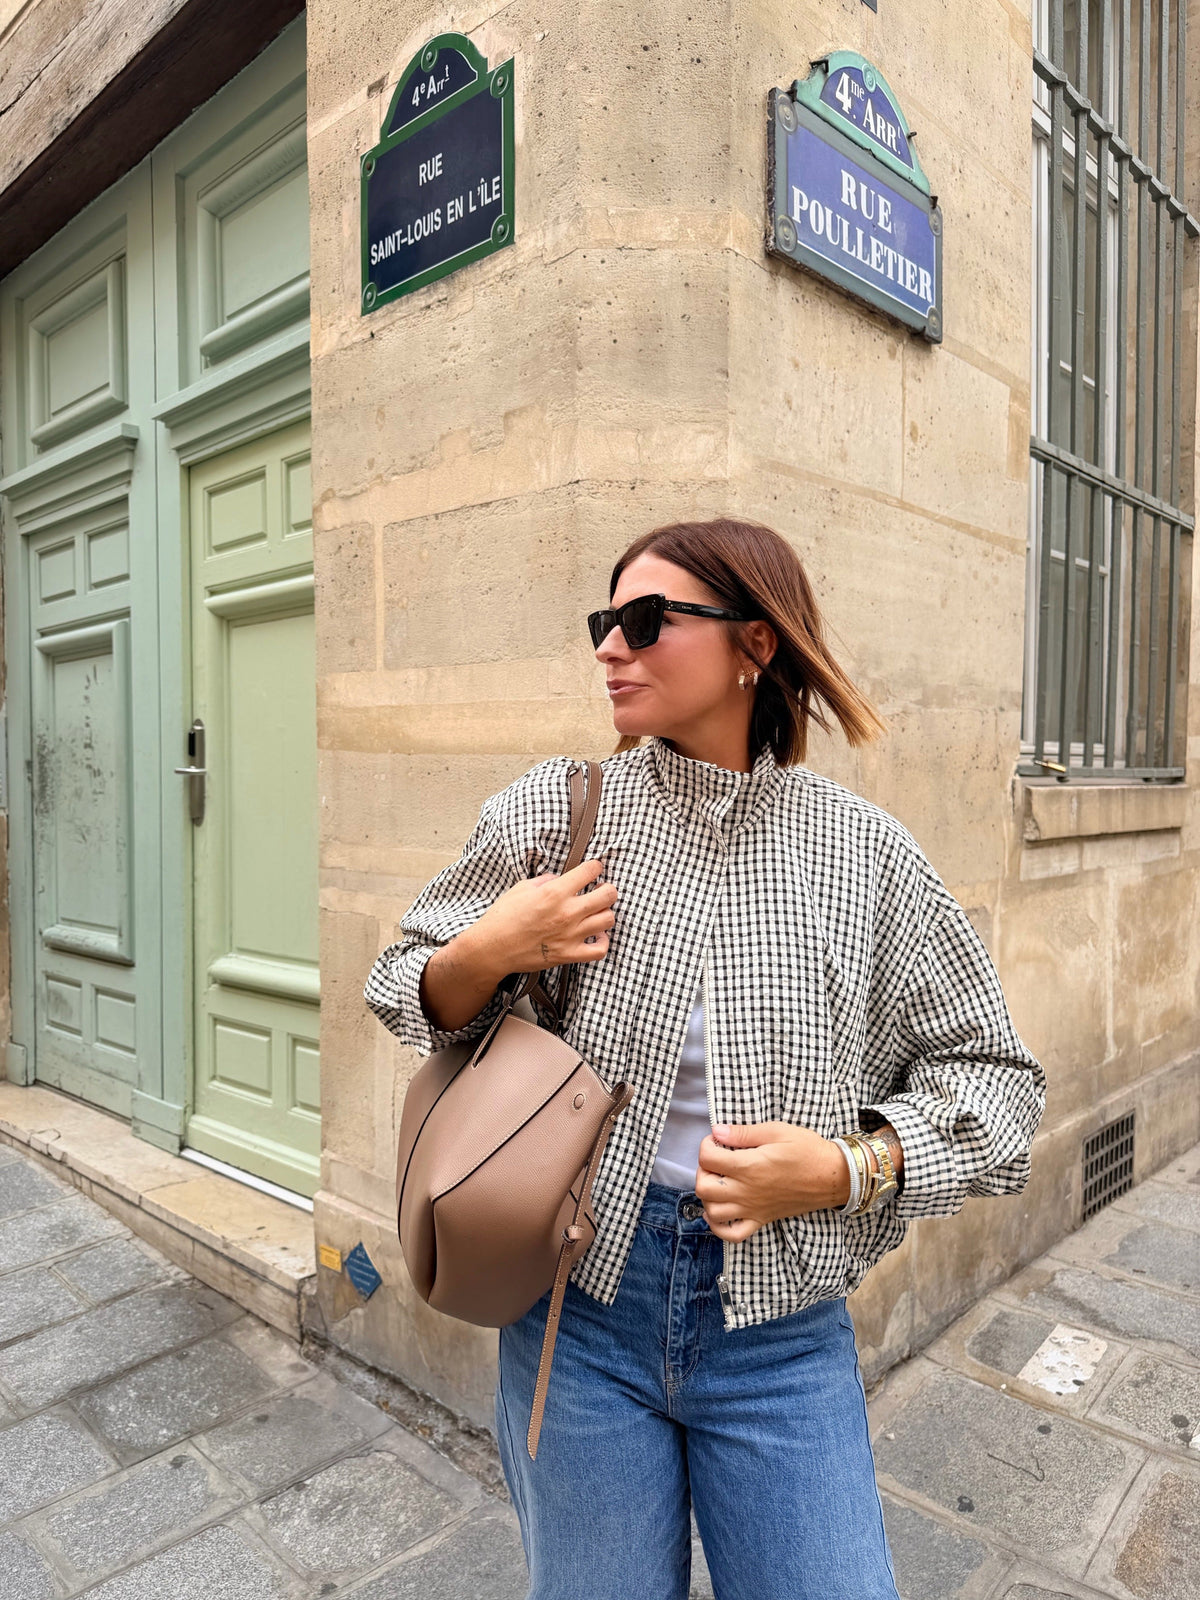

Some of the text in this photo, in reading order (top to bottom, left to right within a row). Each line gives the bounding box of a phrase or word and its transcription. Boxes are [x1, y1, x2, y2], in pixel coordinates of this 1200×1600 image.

[419, 153, 443, 186] RUE
[841, 169, 892, 233] RUE
[371, 208, 441, 265] SAINT-LOUIS
[447, 196, 463, 224] EN
[792, 186, 932, 302] POULLETIER
